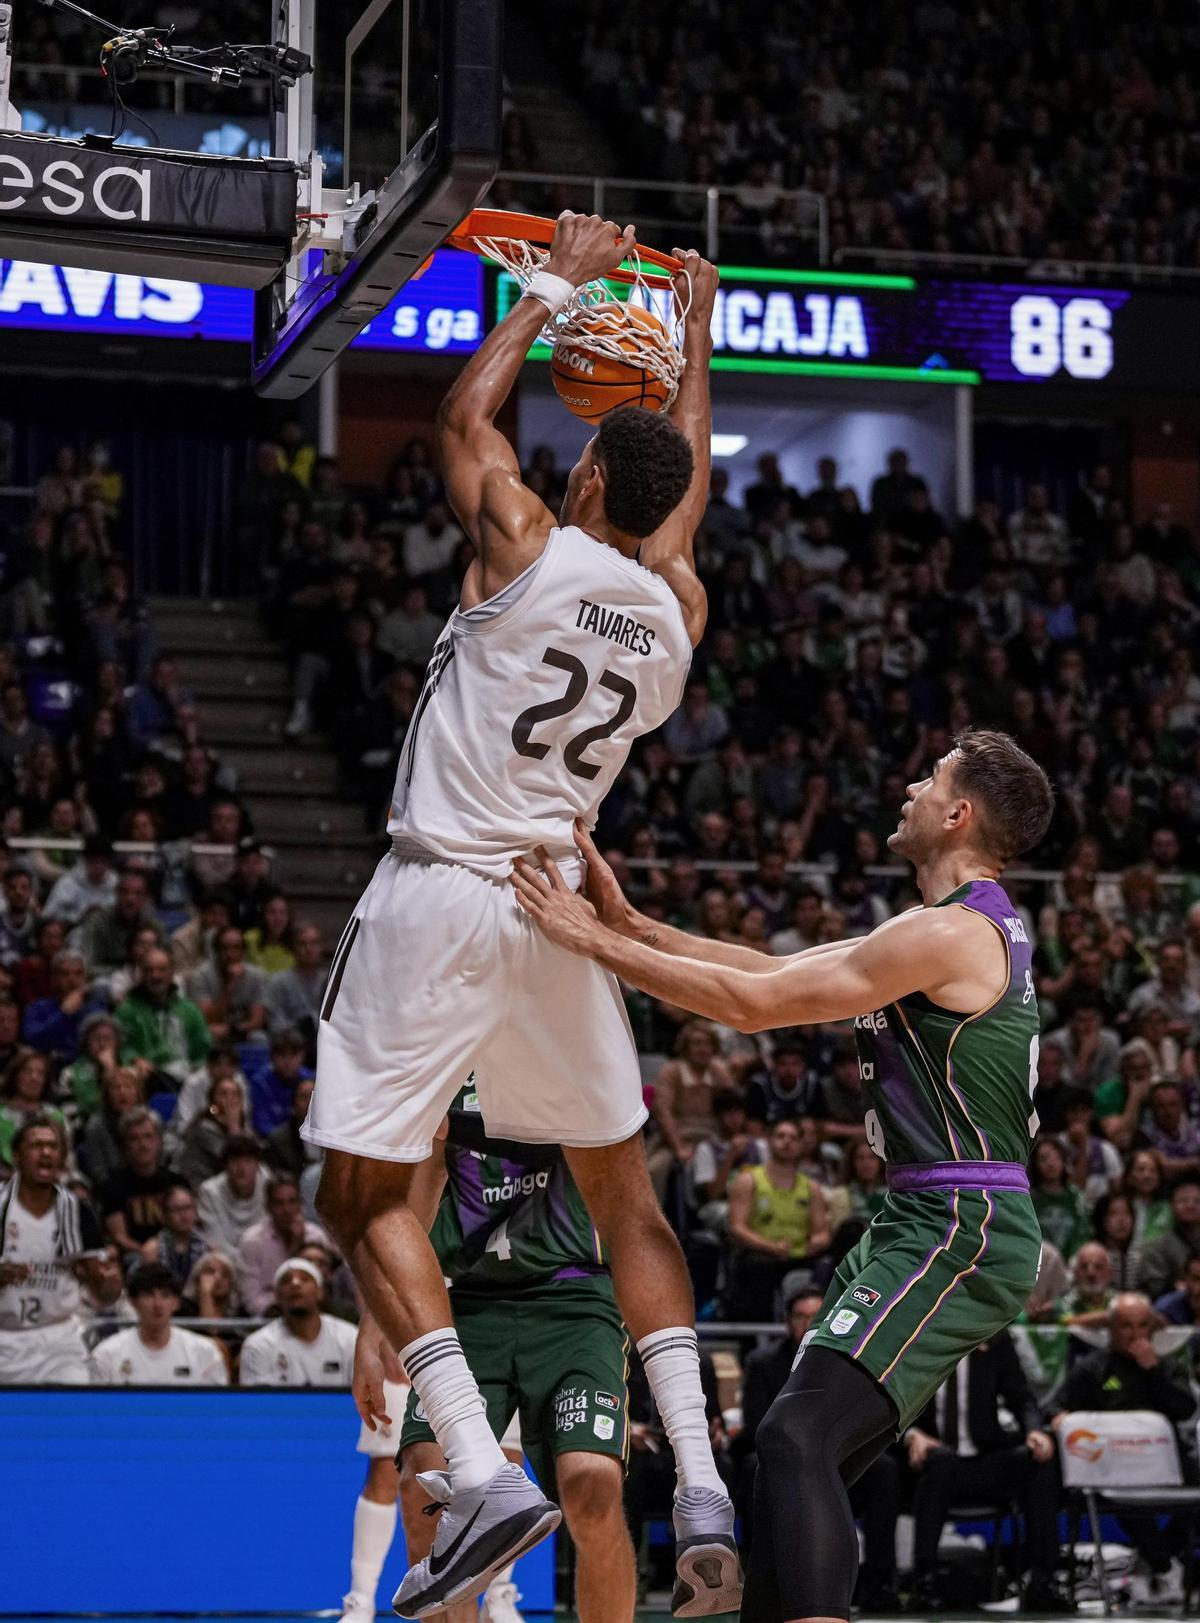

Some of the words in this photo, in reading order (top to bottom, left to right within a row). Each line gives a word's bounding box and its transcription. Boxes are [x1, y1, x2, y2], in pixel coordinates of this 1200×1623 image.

[0, 258, 204, 323] AVIS
[1010, 294, 1114, 379] 86
[554, 344, 594, 375] lson
[575, 599, 656, 656] TAVARES
[511, 646, 637, 780] 22
[853, 1010, 888, 1036] caja
[19, 1296, 41, 1324] 12
[853, 1290, 870, 1303] acb
[597, 1396, 614, 1407] acb
